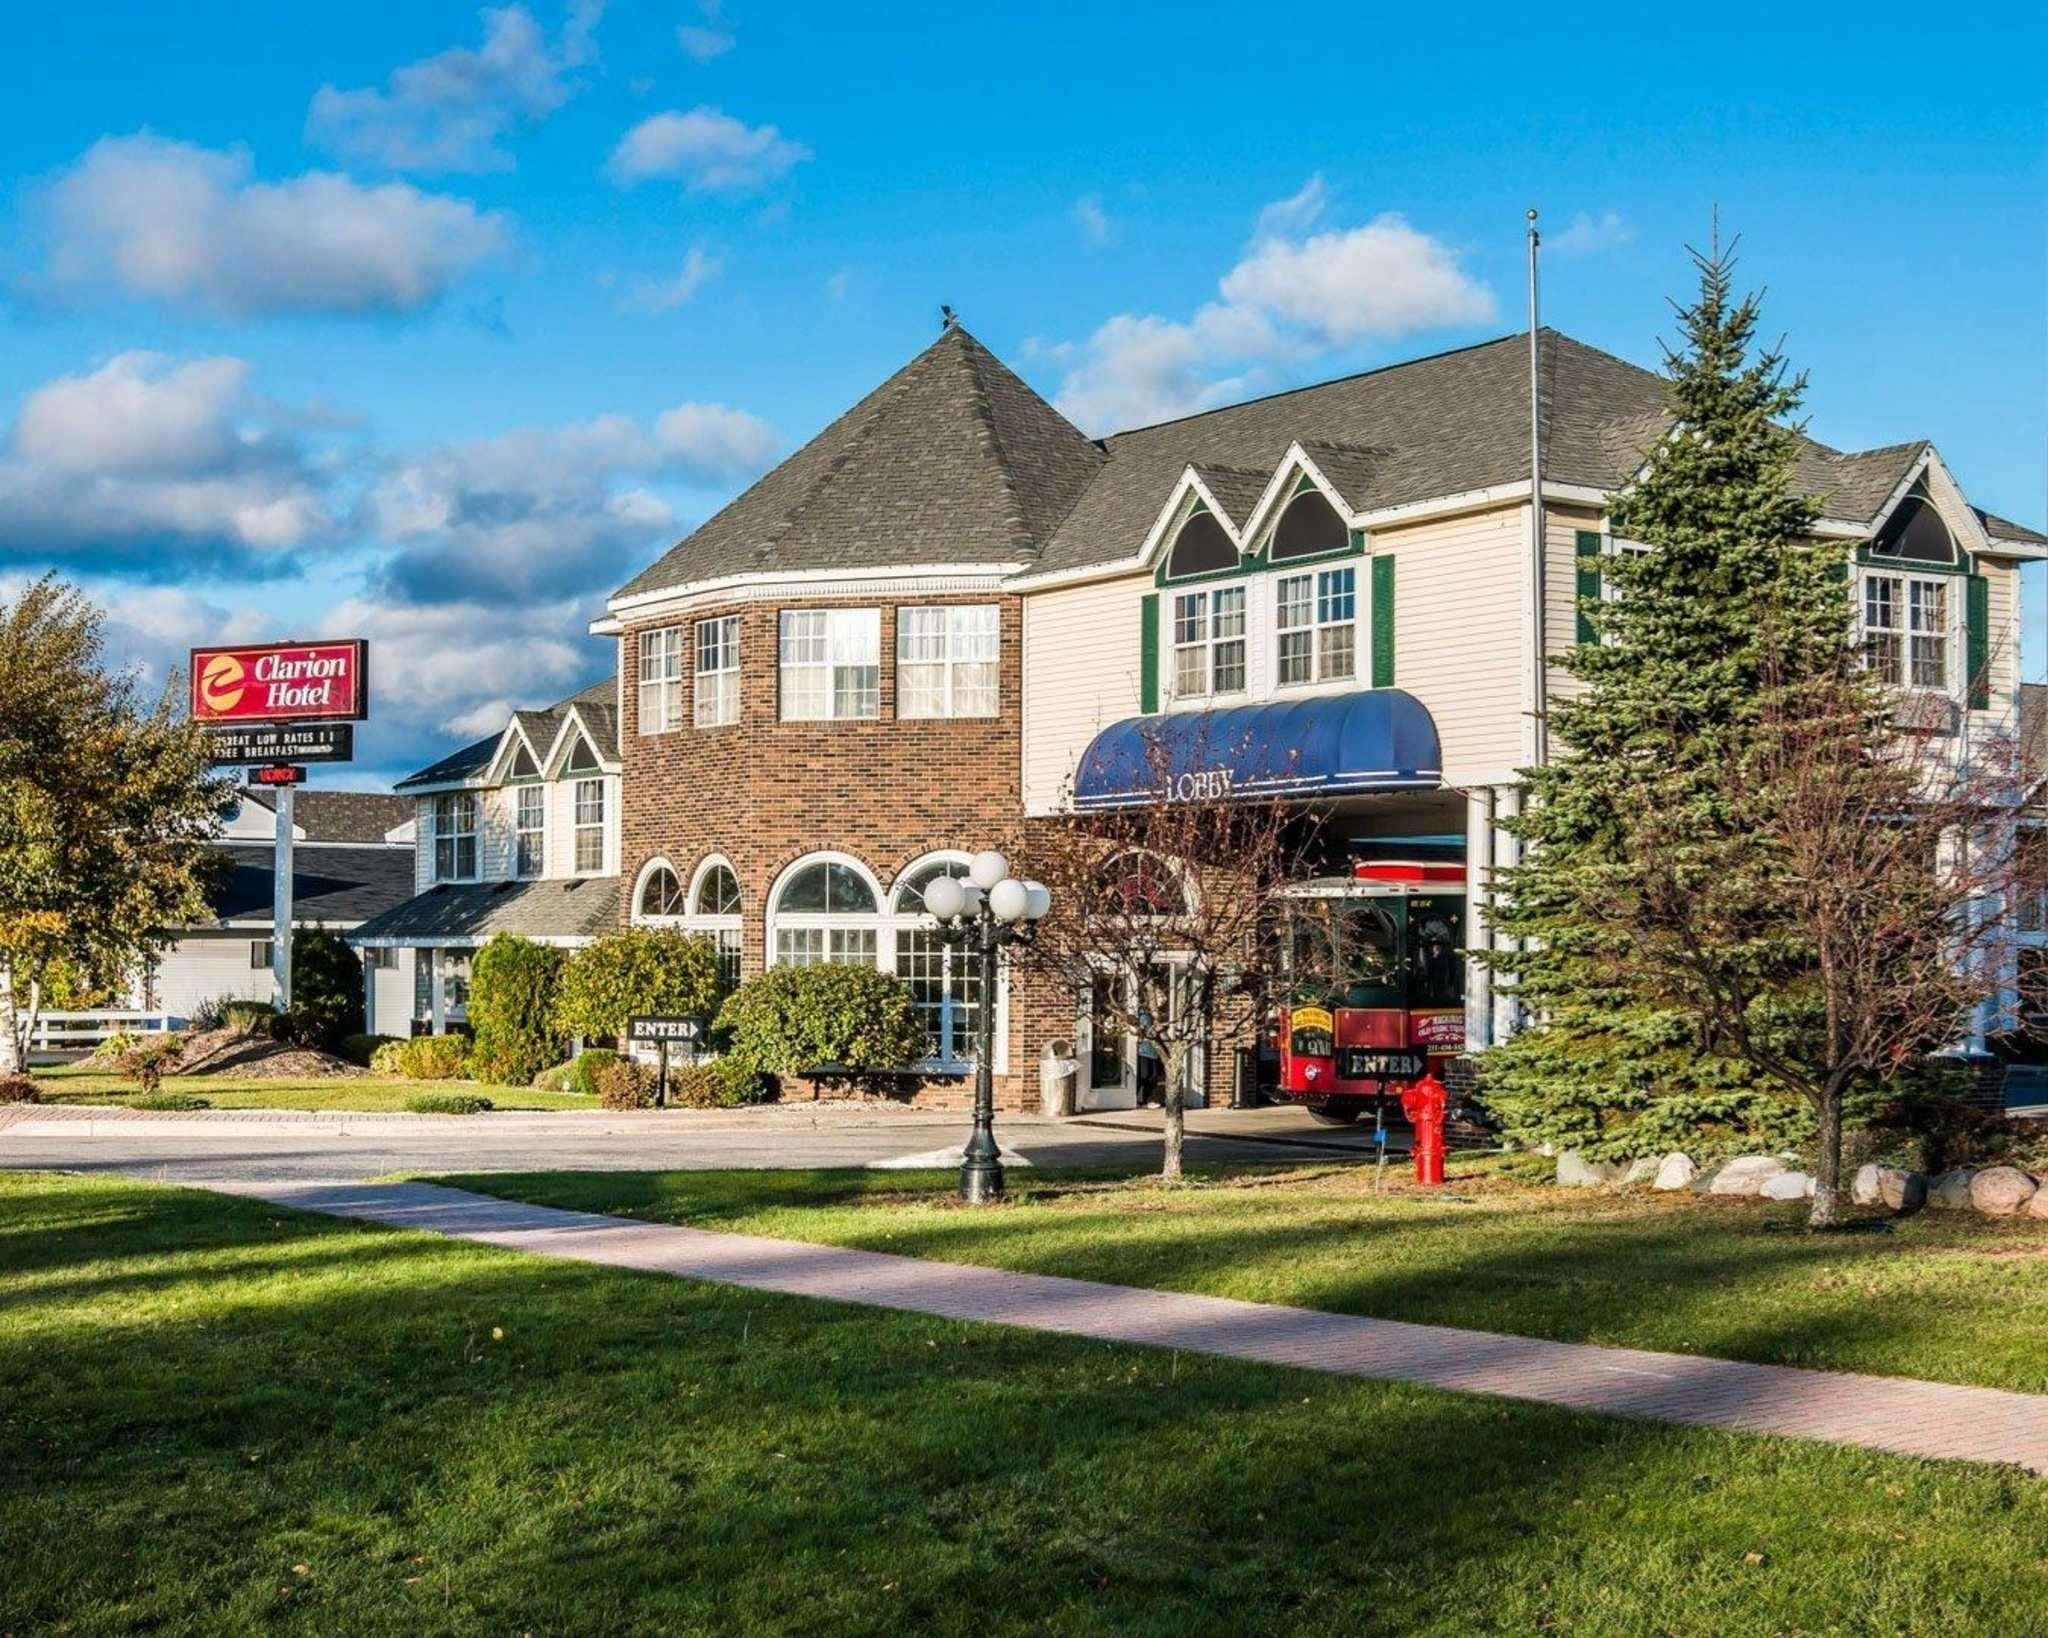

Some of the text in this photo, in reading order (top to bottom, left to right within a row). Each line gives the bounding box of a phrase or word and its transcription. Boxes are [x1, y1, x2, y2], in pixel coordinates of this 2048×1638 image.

[255, 651, 346, 681] Clarion
[266, 679, 331, 707] Hotel
[257, 734, 277, 745] LOW
[284, 732, 314, 744] RATES
[245, 745, 298, 758] BREAKFAST
[634, 1022, 689, 1037] ENTER
[1352, 1055, 1412, 1073] ENTER
